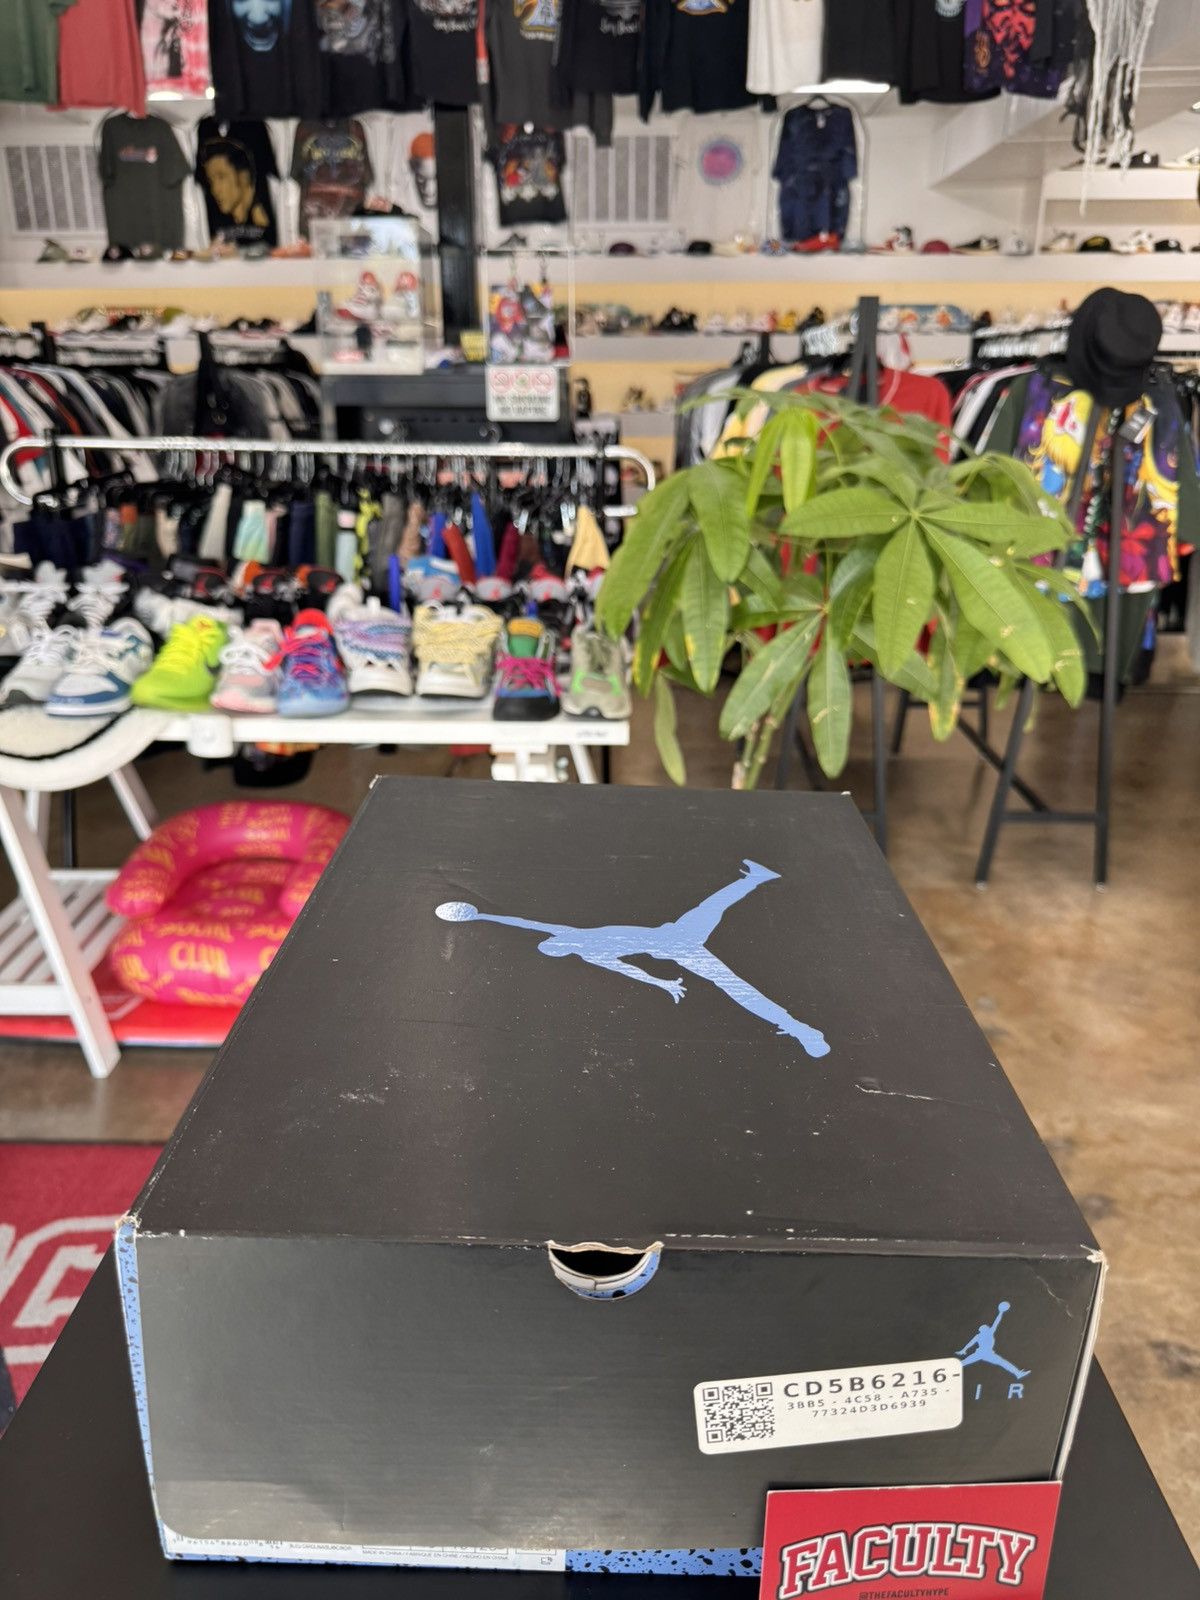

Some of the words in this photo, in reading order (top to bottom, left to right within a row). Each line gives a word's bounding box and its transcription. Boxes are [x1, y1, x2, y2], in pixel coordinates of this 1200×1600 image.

[784, 1368, 961, 1398] CD5B6216-
[974, 1383, 1024, 1400] IR
[844, 1393, 882, 1405] 4C58
[901, 1388, 938, 1399] A735
[812, 1400, 927, 1418] 77324D3D6939
[777, 1522, 1038, 1600] FACULTY
[858, 1588, 949, 1600] @THEFACULTYHYPE
